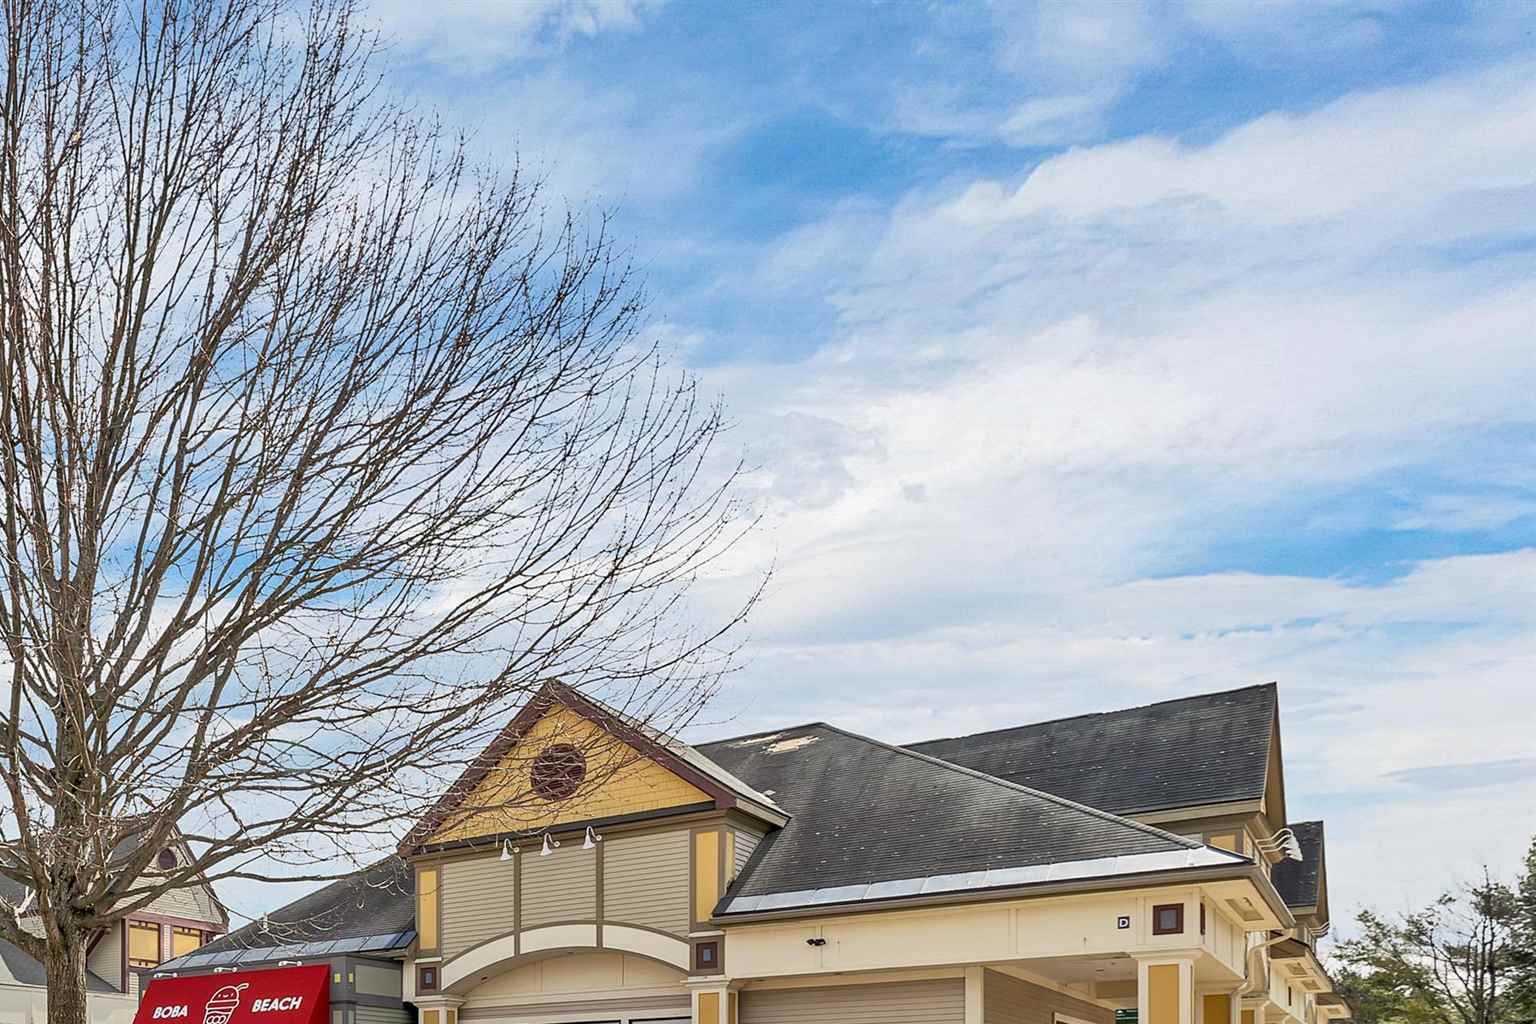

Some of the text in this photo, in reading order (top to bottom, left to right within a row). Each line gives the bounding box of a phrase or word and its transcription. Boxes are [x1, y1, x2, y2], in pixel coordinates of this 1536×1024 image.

[1119, 918, 1129, 928] D
[153, 996, 303, 1019] BOBA BEACH
